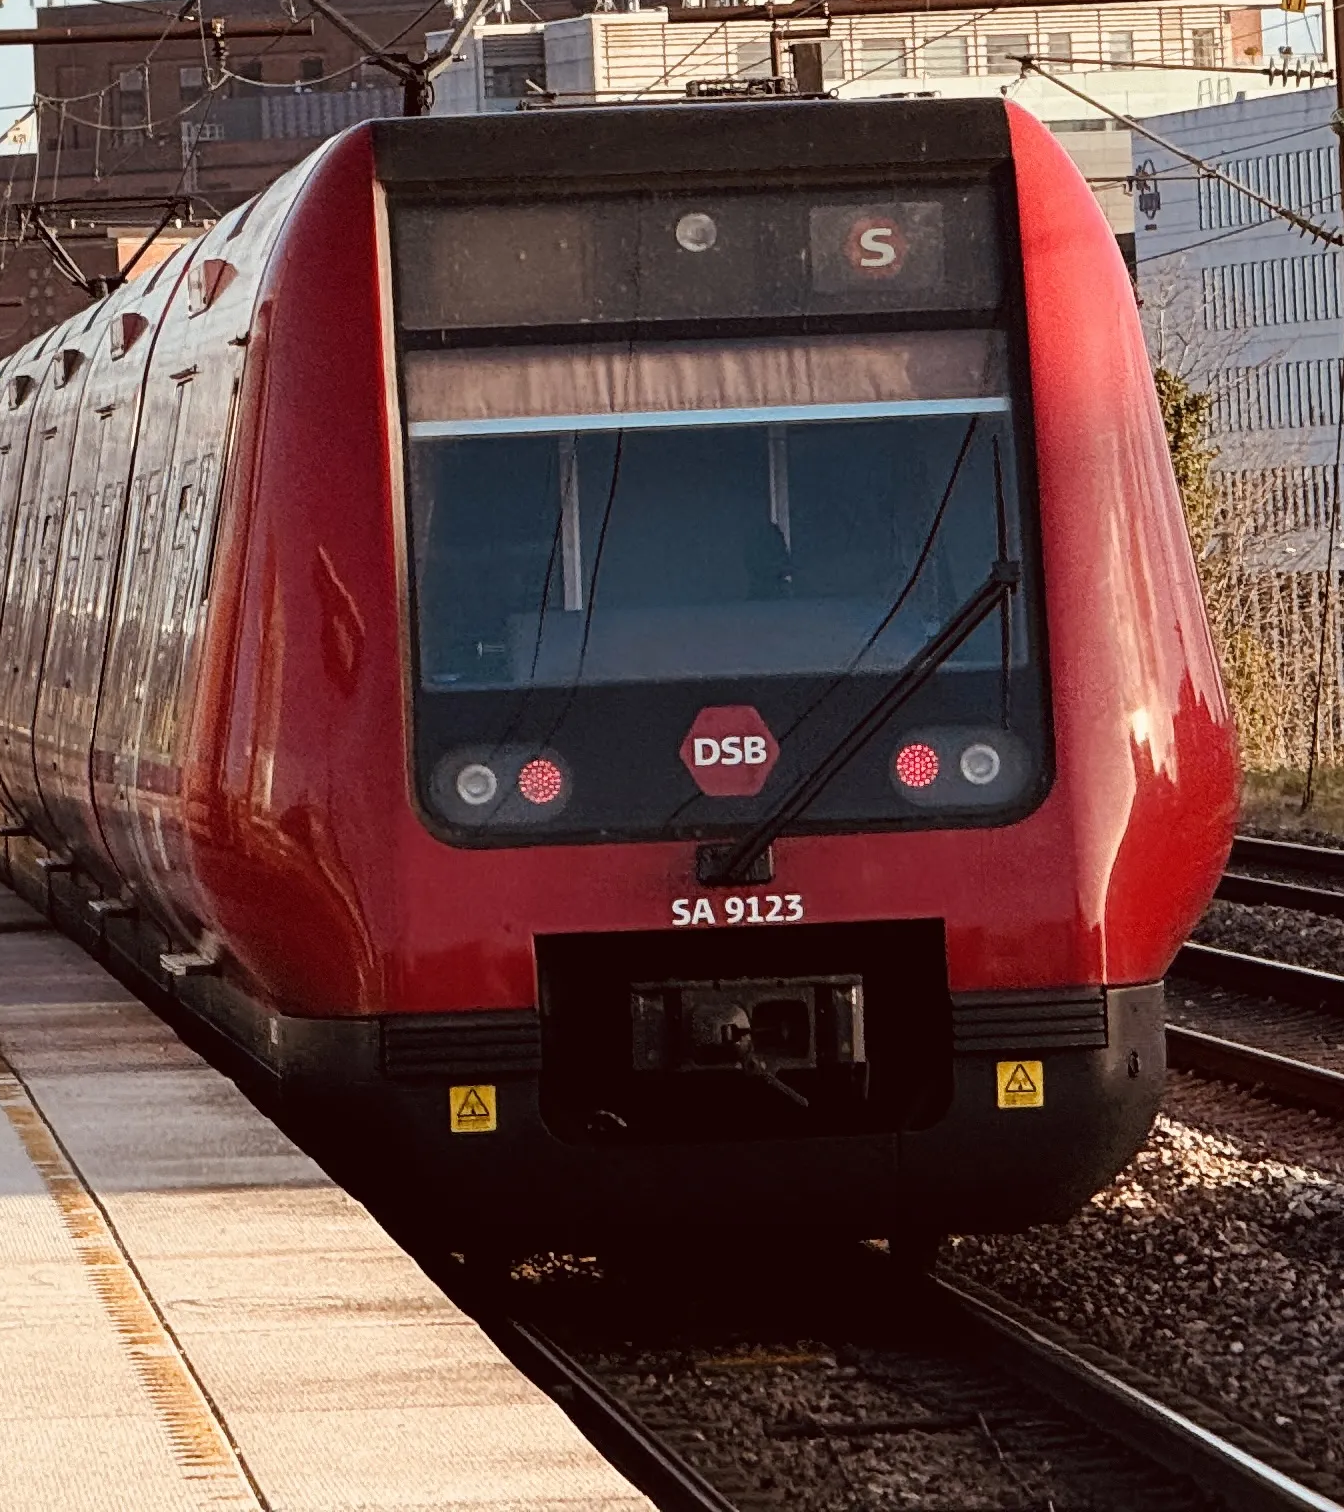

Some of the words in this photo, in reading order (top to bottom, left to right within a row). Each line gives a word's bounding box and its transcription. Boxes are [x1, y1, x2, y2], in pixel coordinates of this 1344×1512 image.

[860, 227, 896, 267] S
[693, 736, 768, 767] DSB
[671, 898, 716, 926] SA
[724, 894, 804, 924] 9123
